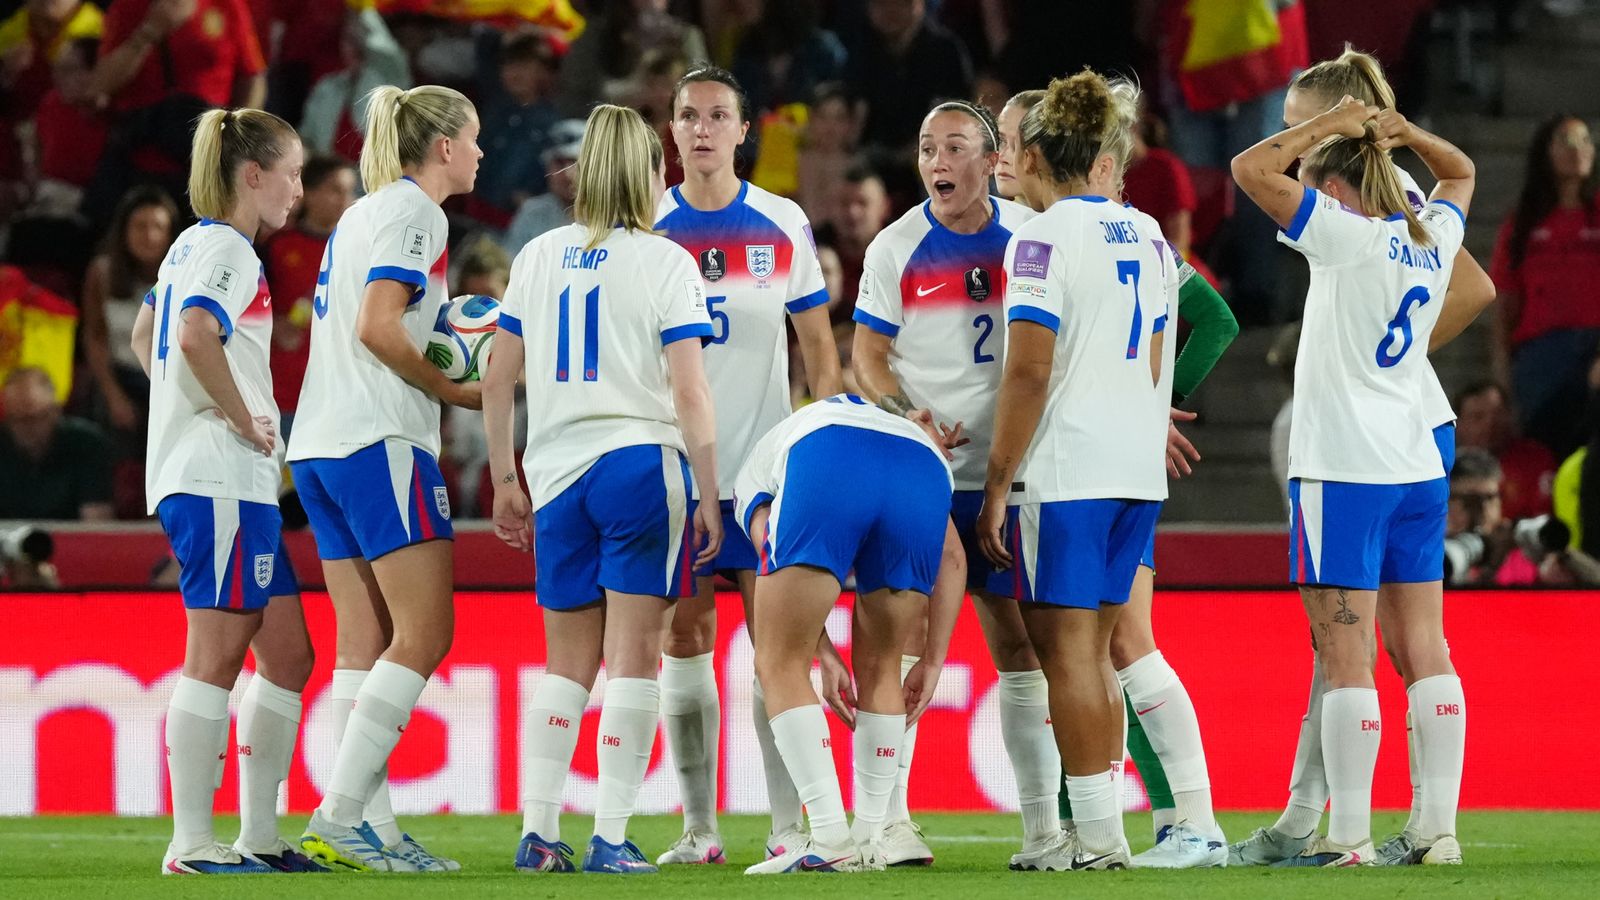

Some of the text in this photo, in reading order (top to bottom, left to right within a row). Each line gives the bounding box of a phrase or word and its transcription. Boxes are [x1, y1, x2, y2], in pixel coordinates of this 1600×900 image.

[1099, 220, 1139, 244] JAMES
[562, 246, 609, 271] HEMP
[1116, 260, 1142, 360] 7
[705, 295, 730, 345] 5
[556, 283, 601, 382] 11
[973, 314, 995, 364] 2
[1436, 703, 1460, 716] ENG
[548, 715, 570, 729] ENG
[1361, 719, 1380, 731] ENG
[602, 734, 621, 747] ENG
[822, 737, 832, 748] EN
[876, 747, 896, 758] ENG
